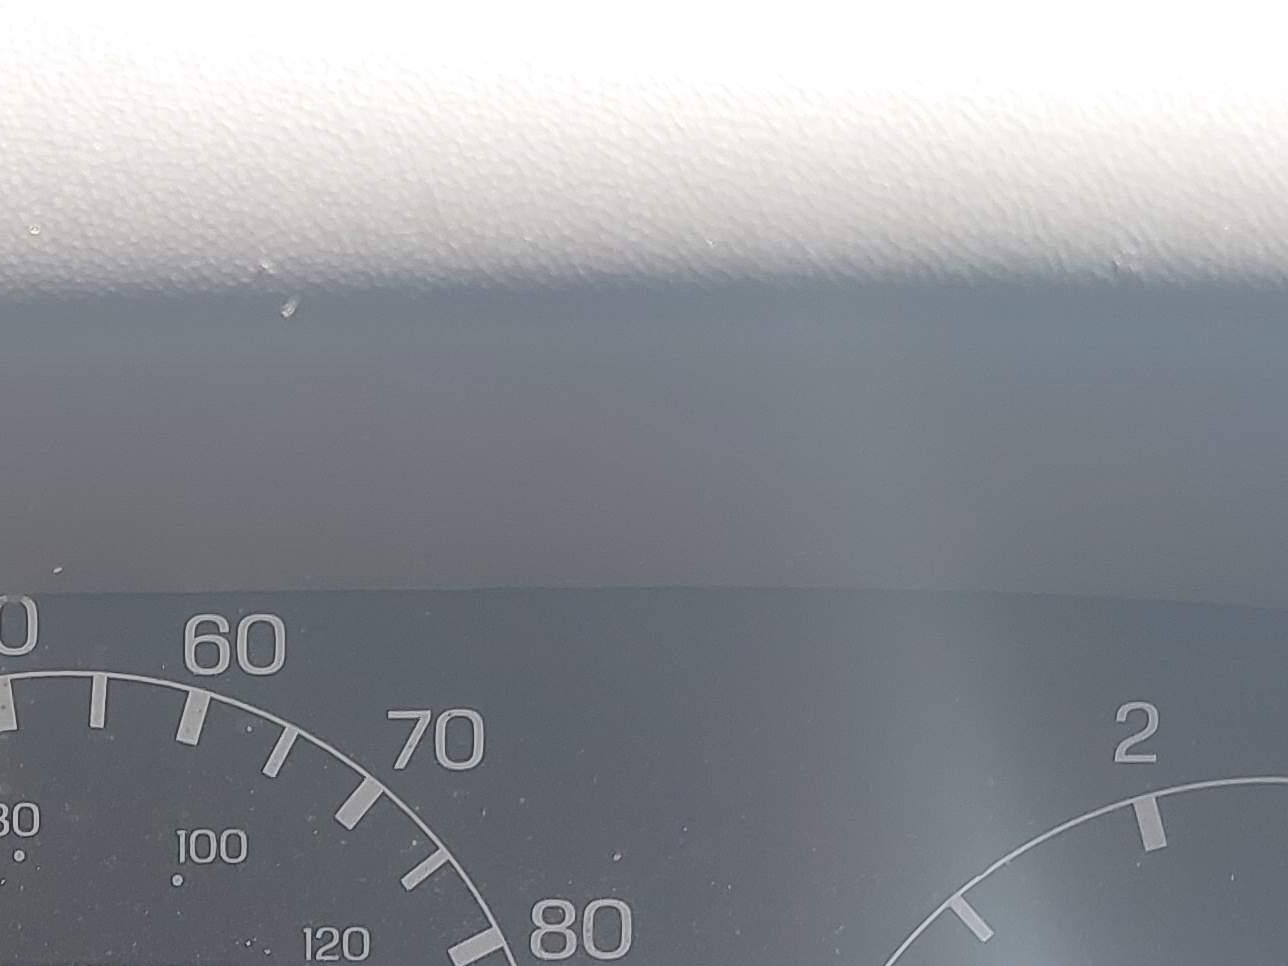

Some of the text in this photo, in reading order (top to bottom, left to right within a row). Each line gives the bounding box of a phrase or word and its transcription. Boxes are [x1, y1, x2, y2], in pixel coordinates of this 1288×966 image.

[183, 613, 287, 676] 60
[387, 708, 485, 771] 70
[1114, 701, 1160, 763] 2
[176, 828, 249, 864] 100
[302, 927, 372, 961] 120
[529, 899, 633, 961] 80
